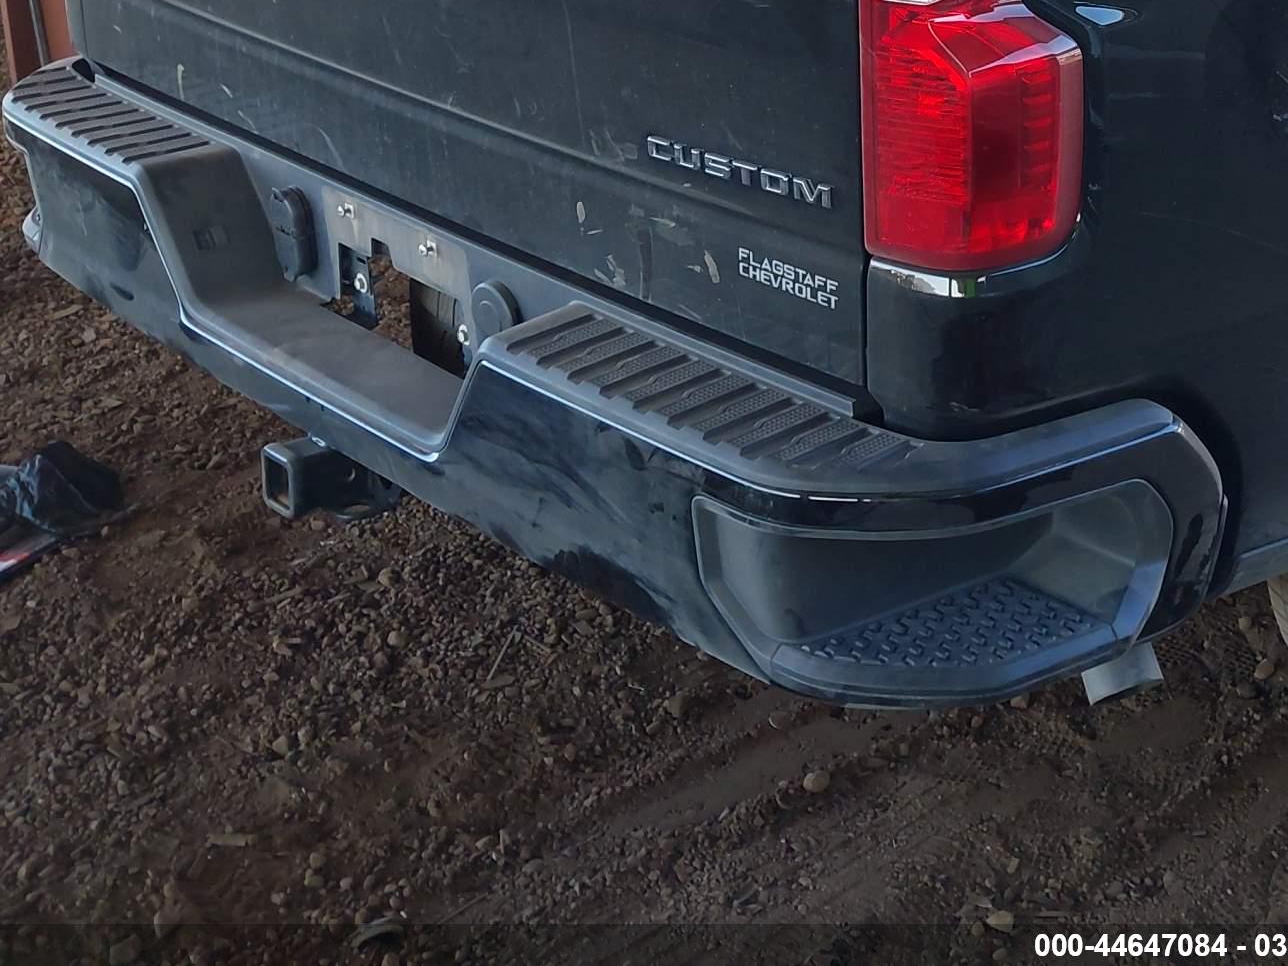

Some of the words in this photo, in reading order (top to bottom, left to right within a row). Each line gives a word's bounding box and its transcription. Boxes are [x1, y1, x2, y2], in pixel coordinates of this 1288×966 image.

[647, 135, 834, 209] CUSTOM
[738, 247, 839, 293] FLAGSTAFF
[738, 261, 839, 310] CHEVROLET
